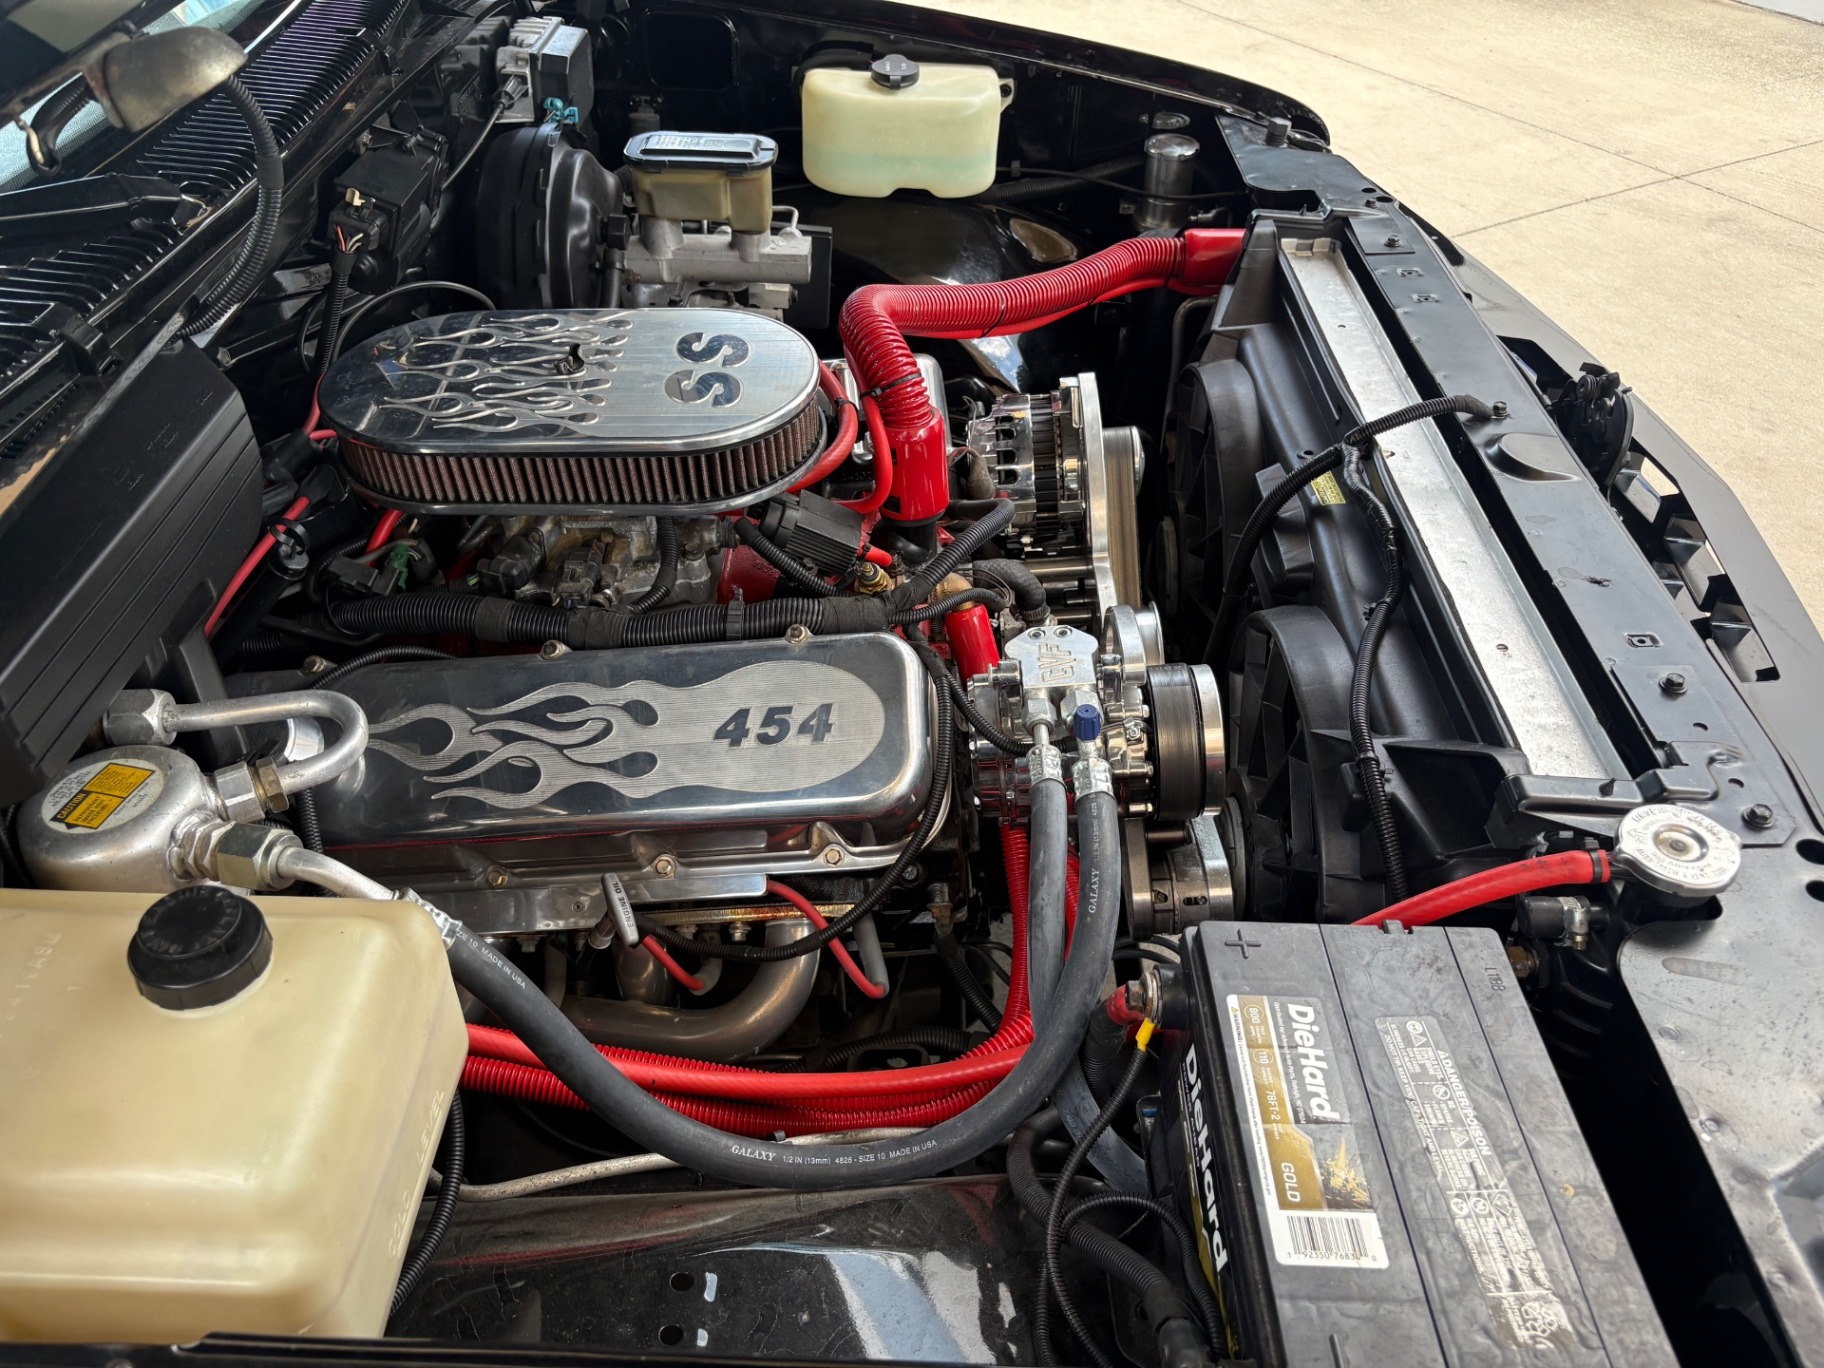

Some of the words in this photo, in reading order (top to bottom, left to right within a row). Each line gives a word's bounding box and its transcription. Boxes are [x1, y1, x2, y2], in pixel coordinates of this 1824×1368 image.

[662, 332, 751, 408] SS
[713, 702, 834, 747] 454
[57, 793, 87, 819] CAUTION
[612, 881, 622, 894] OIL
[1088, 867, 1100, 913] GALAXY
[617, 896, 634, 929] ENGINE
[469, 939, 479, 948] 10
[481, 946, 502, 968] MADE
[503, 964, 511, 976] IN
[512, 971, 526, 989] USA
[1248, 1007, 1261, 1024] 800
[1257, 1050, 1269, 1064] 110
[1288, 1002, 1340, 1123] DieHard
[1264, 1089, 1281, 1120] 78FT-2
[1441, 1058, 1492, 1156] DANGER/POISON
[416, 1090, 445, 1166] LEVEL
[731, 1144, 776, 1161] GALAXY
[782, 1155, 793, 1164] 1/2
[795, 1156, 803, 1164] IN
[804, 1156, 831, 1165] (13mm)
[858, 1153, 876, 1163] SIZE
[877, 1152, 886, 1160] 10
[889, 1146, 911, 1159] MADE
[912, 1144, 920, 1153] IN
[922, 1139, 937, 1151] USA
[1185, 1043, 1229, 1273] DieHard
[1279, 1161, 1302, 1202] GOLD
